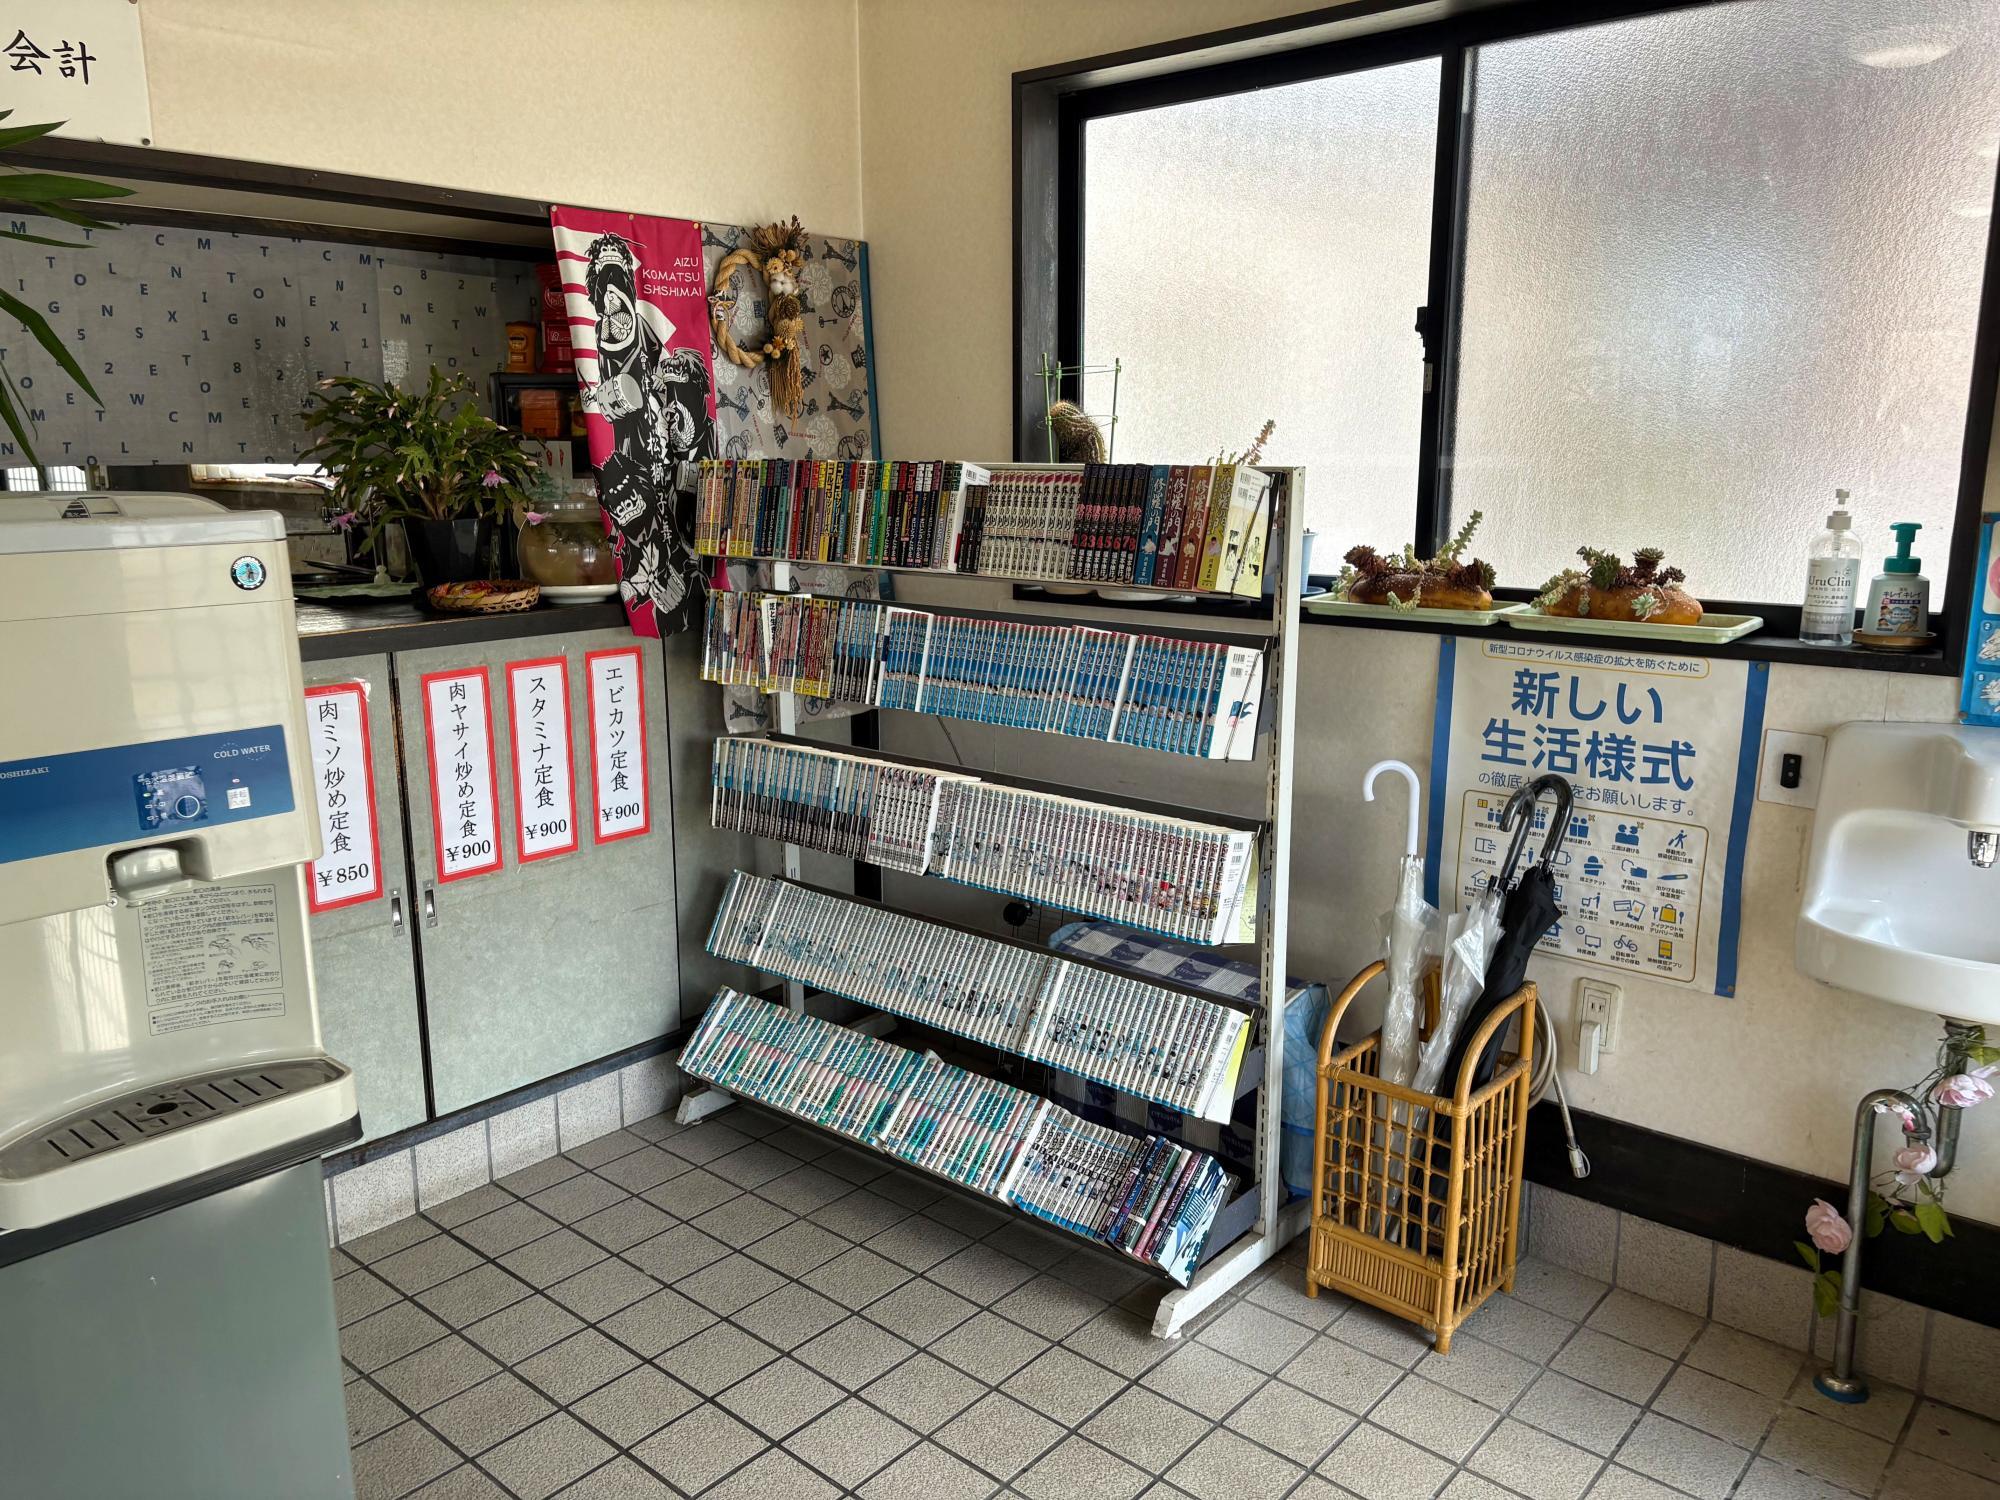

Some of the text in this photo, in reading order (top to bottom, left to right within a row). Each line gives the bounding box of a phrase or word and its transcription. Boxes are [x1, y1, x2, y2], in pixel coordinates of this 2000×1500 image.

[2, 29, 97, 85] 会計
[642, 269, 700, 282] KOMATSU
[673, 257, 699, 267] AIZU
[1808, 576, 1851, 587] UruClin
[1488, 643, 1700, 673] 新型コロナウイルス感染症の拡大を防ぐために
[1511, 668, 1662, 724] 新しい
[530, 677, 555, 809] スタミナ定食
[606, 667, 629, 793] エビカツ定食
[213, 744, 271, 759] COLD WATER
[449, 681, 479, 838] 肉ヤサイ炒め定食
[1481, 718, 1696, 791] 生活様式
[319, 700, 352, 855] 肉ミソ炒め定食
[1479, 771, 1694, 816] の徹底とをお願いします。
[601, 802, 640, 822] ¥900
[525, 819, 567, 839] ¥900
[446, 840, 491, 862] ¥900
[317, 863, 369, 887] ¥850
